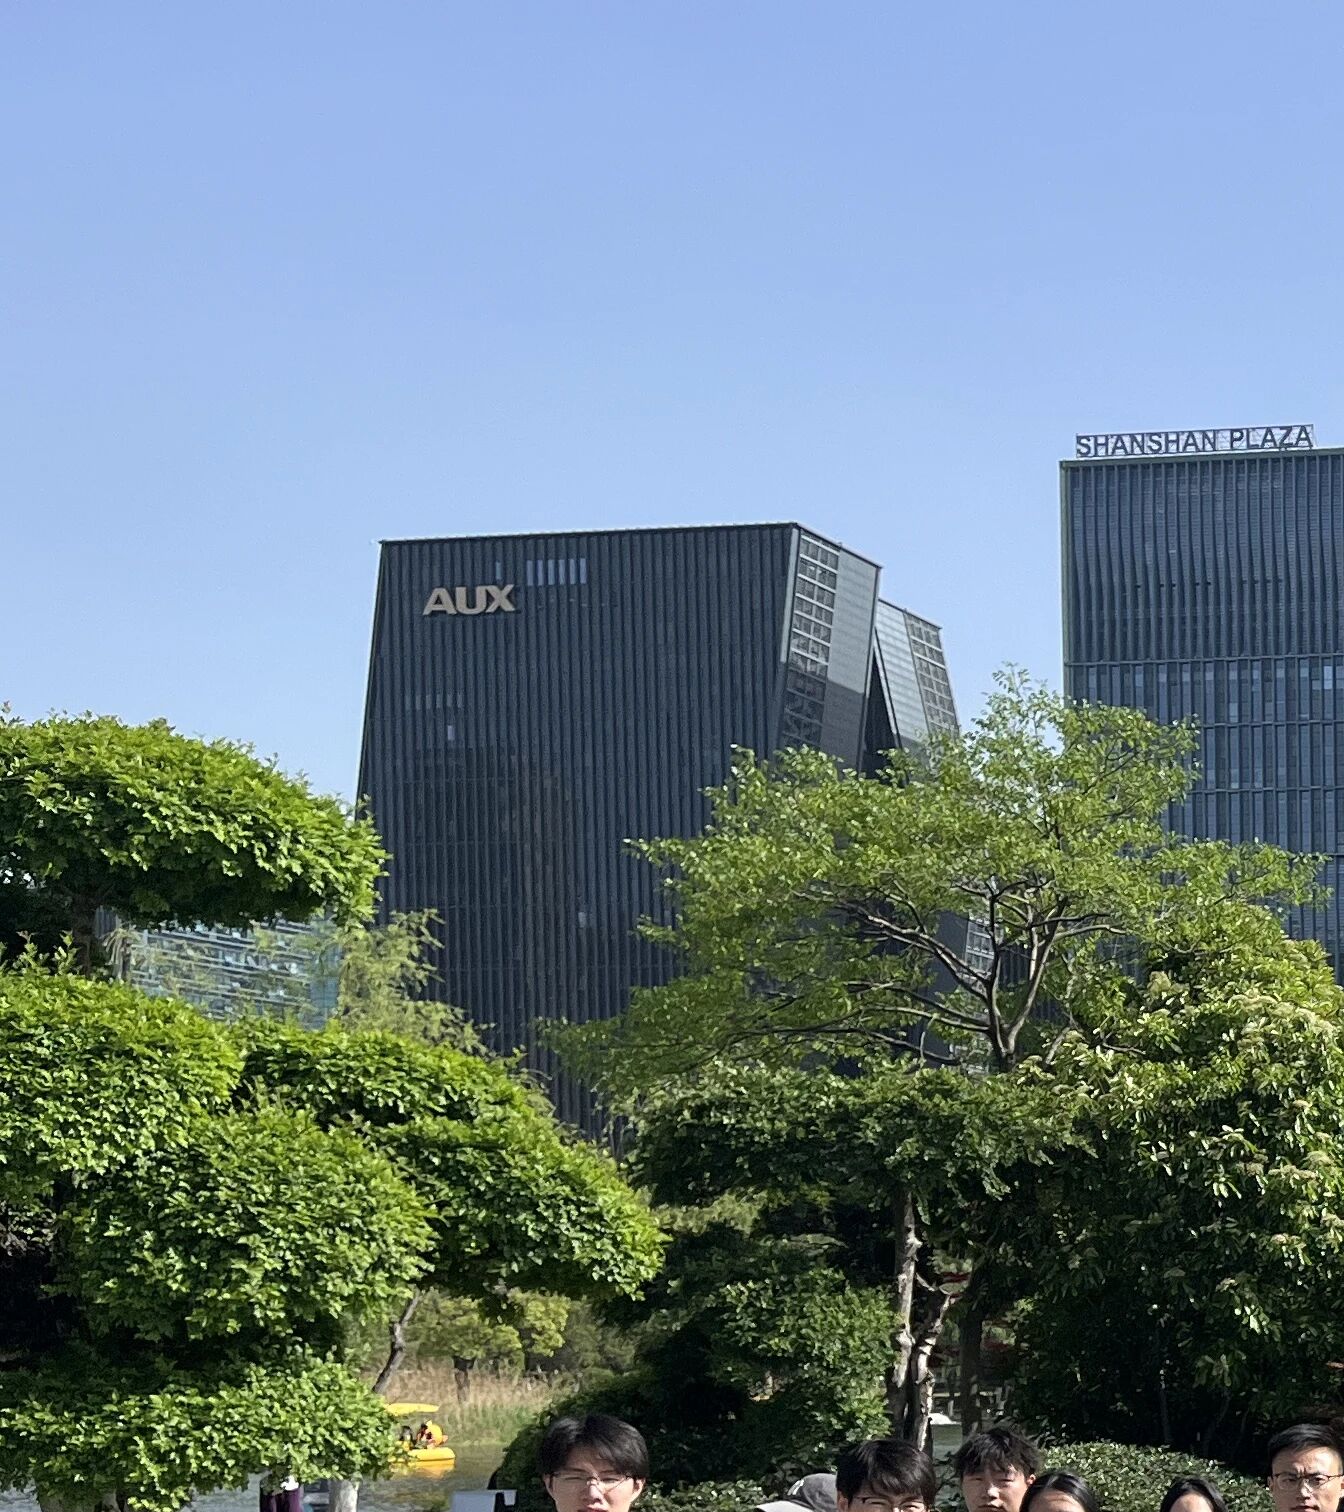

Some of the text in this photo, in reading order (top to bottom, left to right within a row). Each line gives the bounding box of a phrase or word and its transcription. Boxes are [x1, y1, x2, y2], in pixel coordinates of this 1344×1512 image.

[1076, 425, 1313, 457] SHANSHAN PLAZA
[423, 584, 515, 615] AUX
